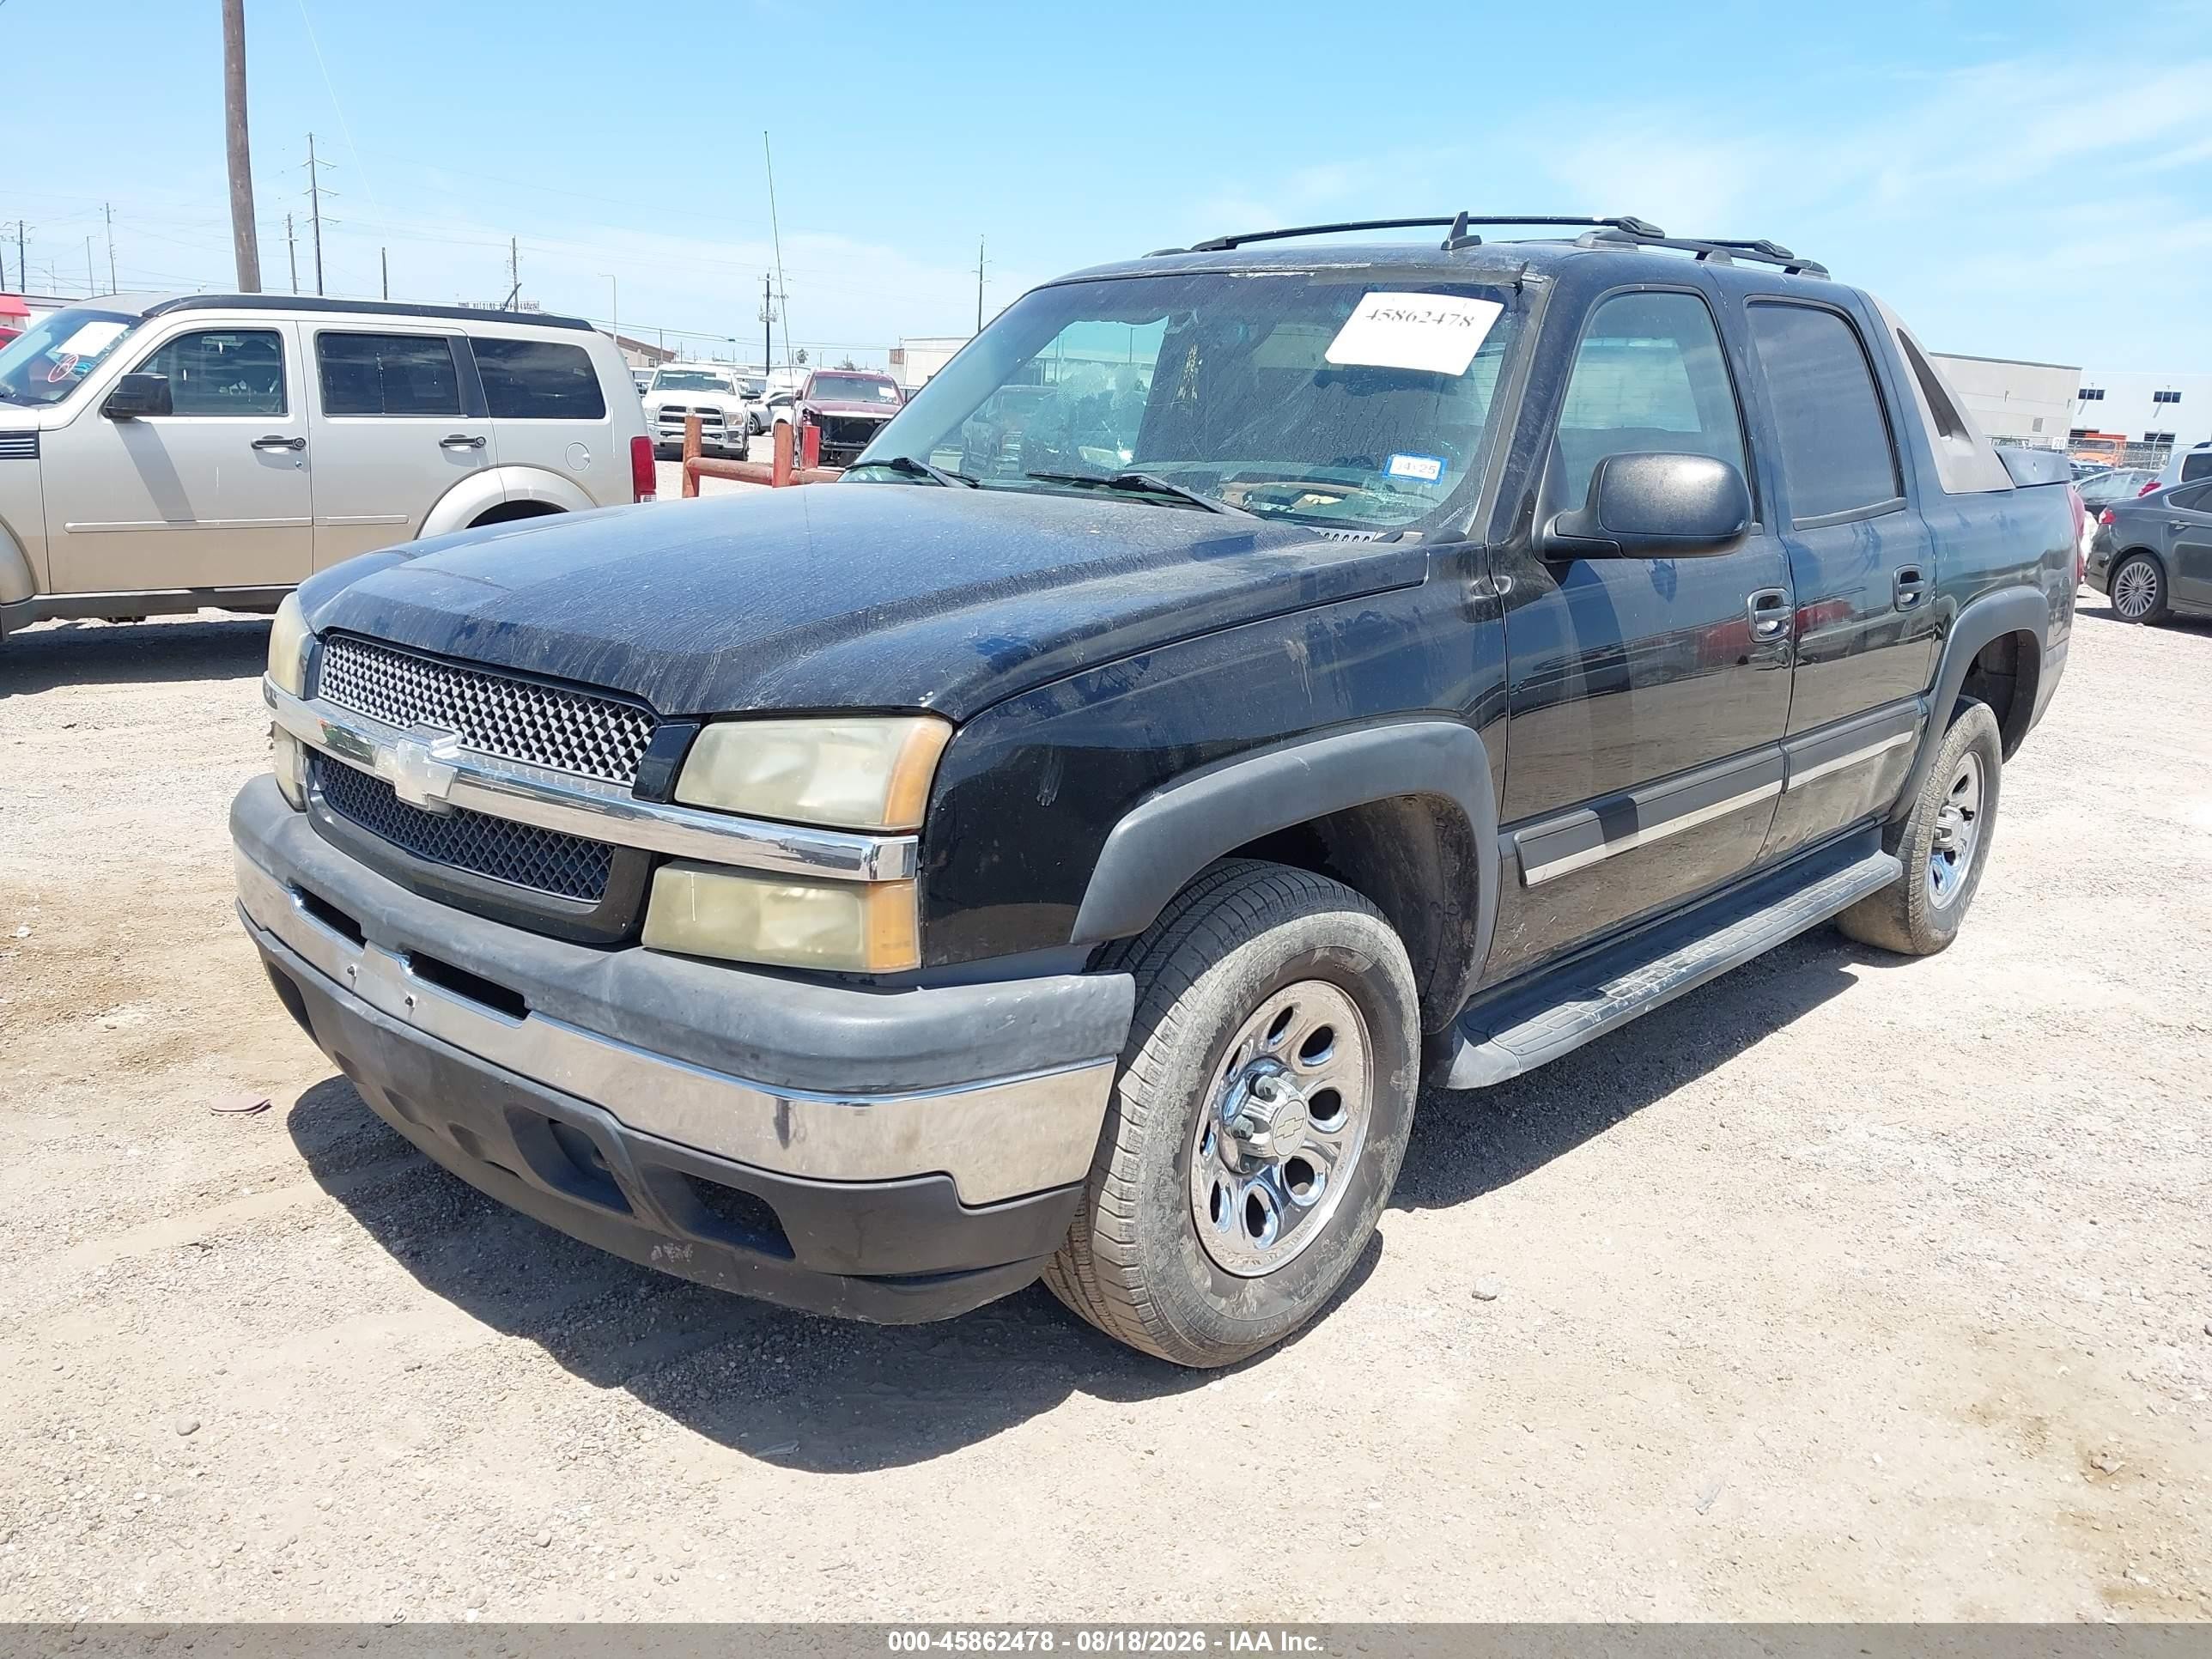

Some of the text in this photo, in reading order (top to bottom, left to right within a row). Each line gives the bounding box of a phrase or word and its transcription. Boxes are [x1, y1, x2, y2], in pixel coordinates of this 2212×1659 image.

[1365, 308, 1474, 327] 45862478
[2053, 439, 2064, 448] 20
[1418, 463, 1437, 475] 25
